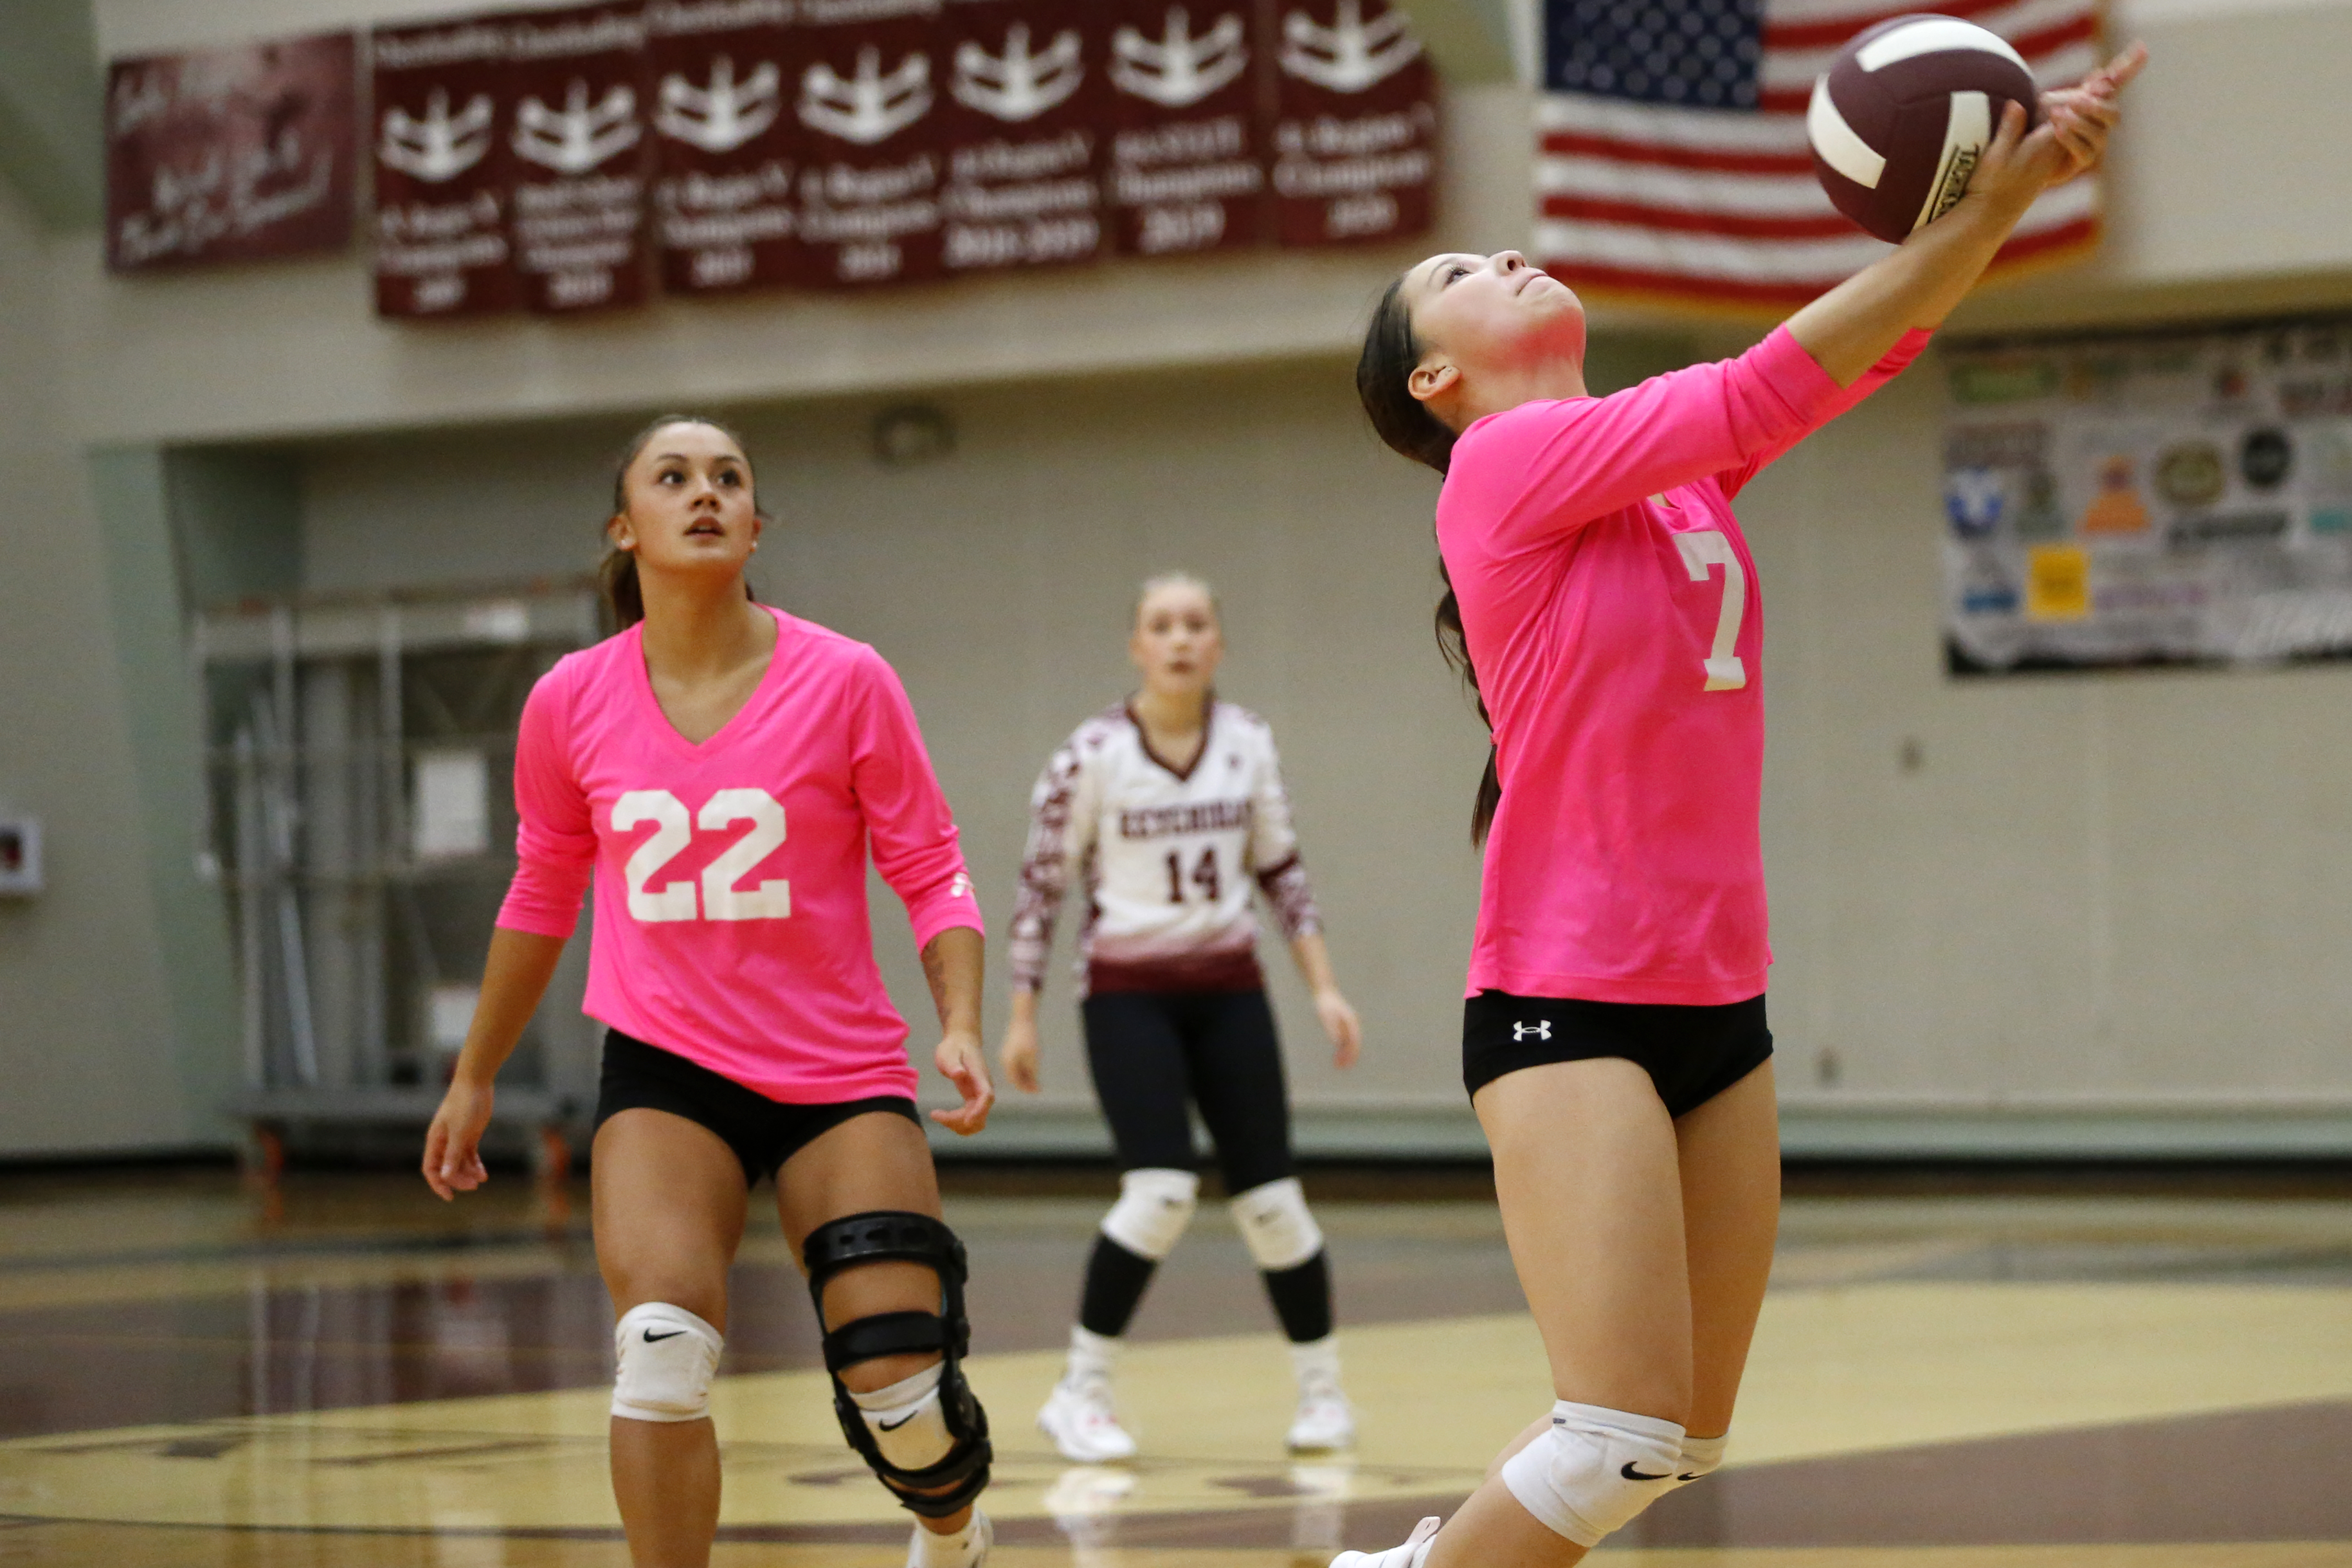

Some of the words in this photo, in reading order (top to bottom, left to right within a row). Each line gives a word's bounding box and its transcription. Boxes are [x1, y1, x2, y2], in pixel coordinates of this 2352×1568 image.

[1673, 531, 1746, 692] 7
[612, 788, 791, 922] 22
[1166, 847, 1218, 903] 14
